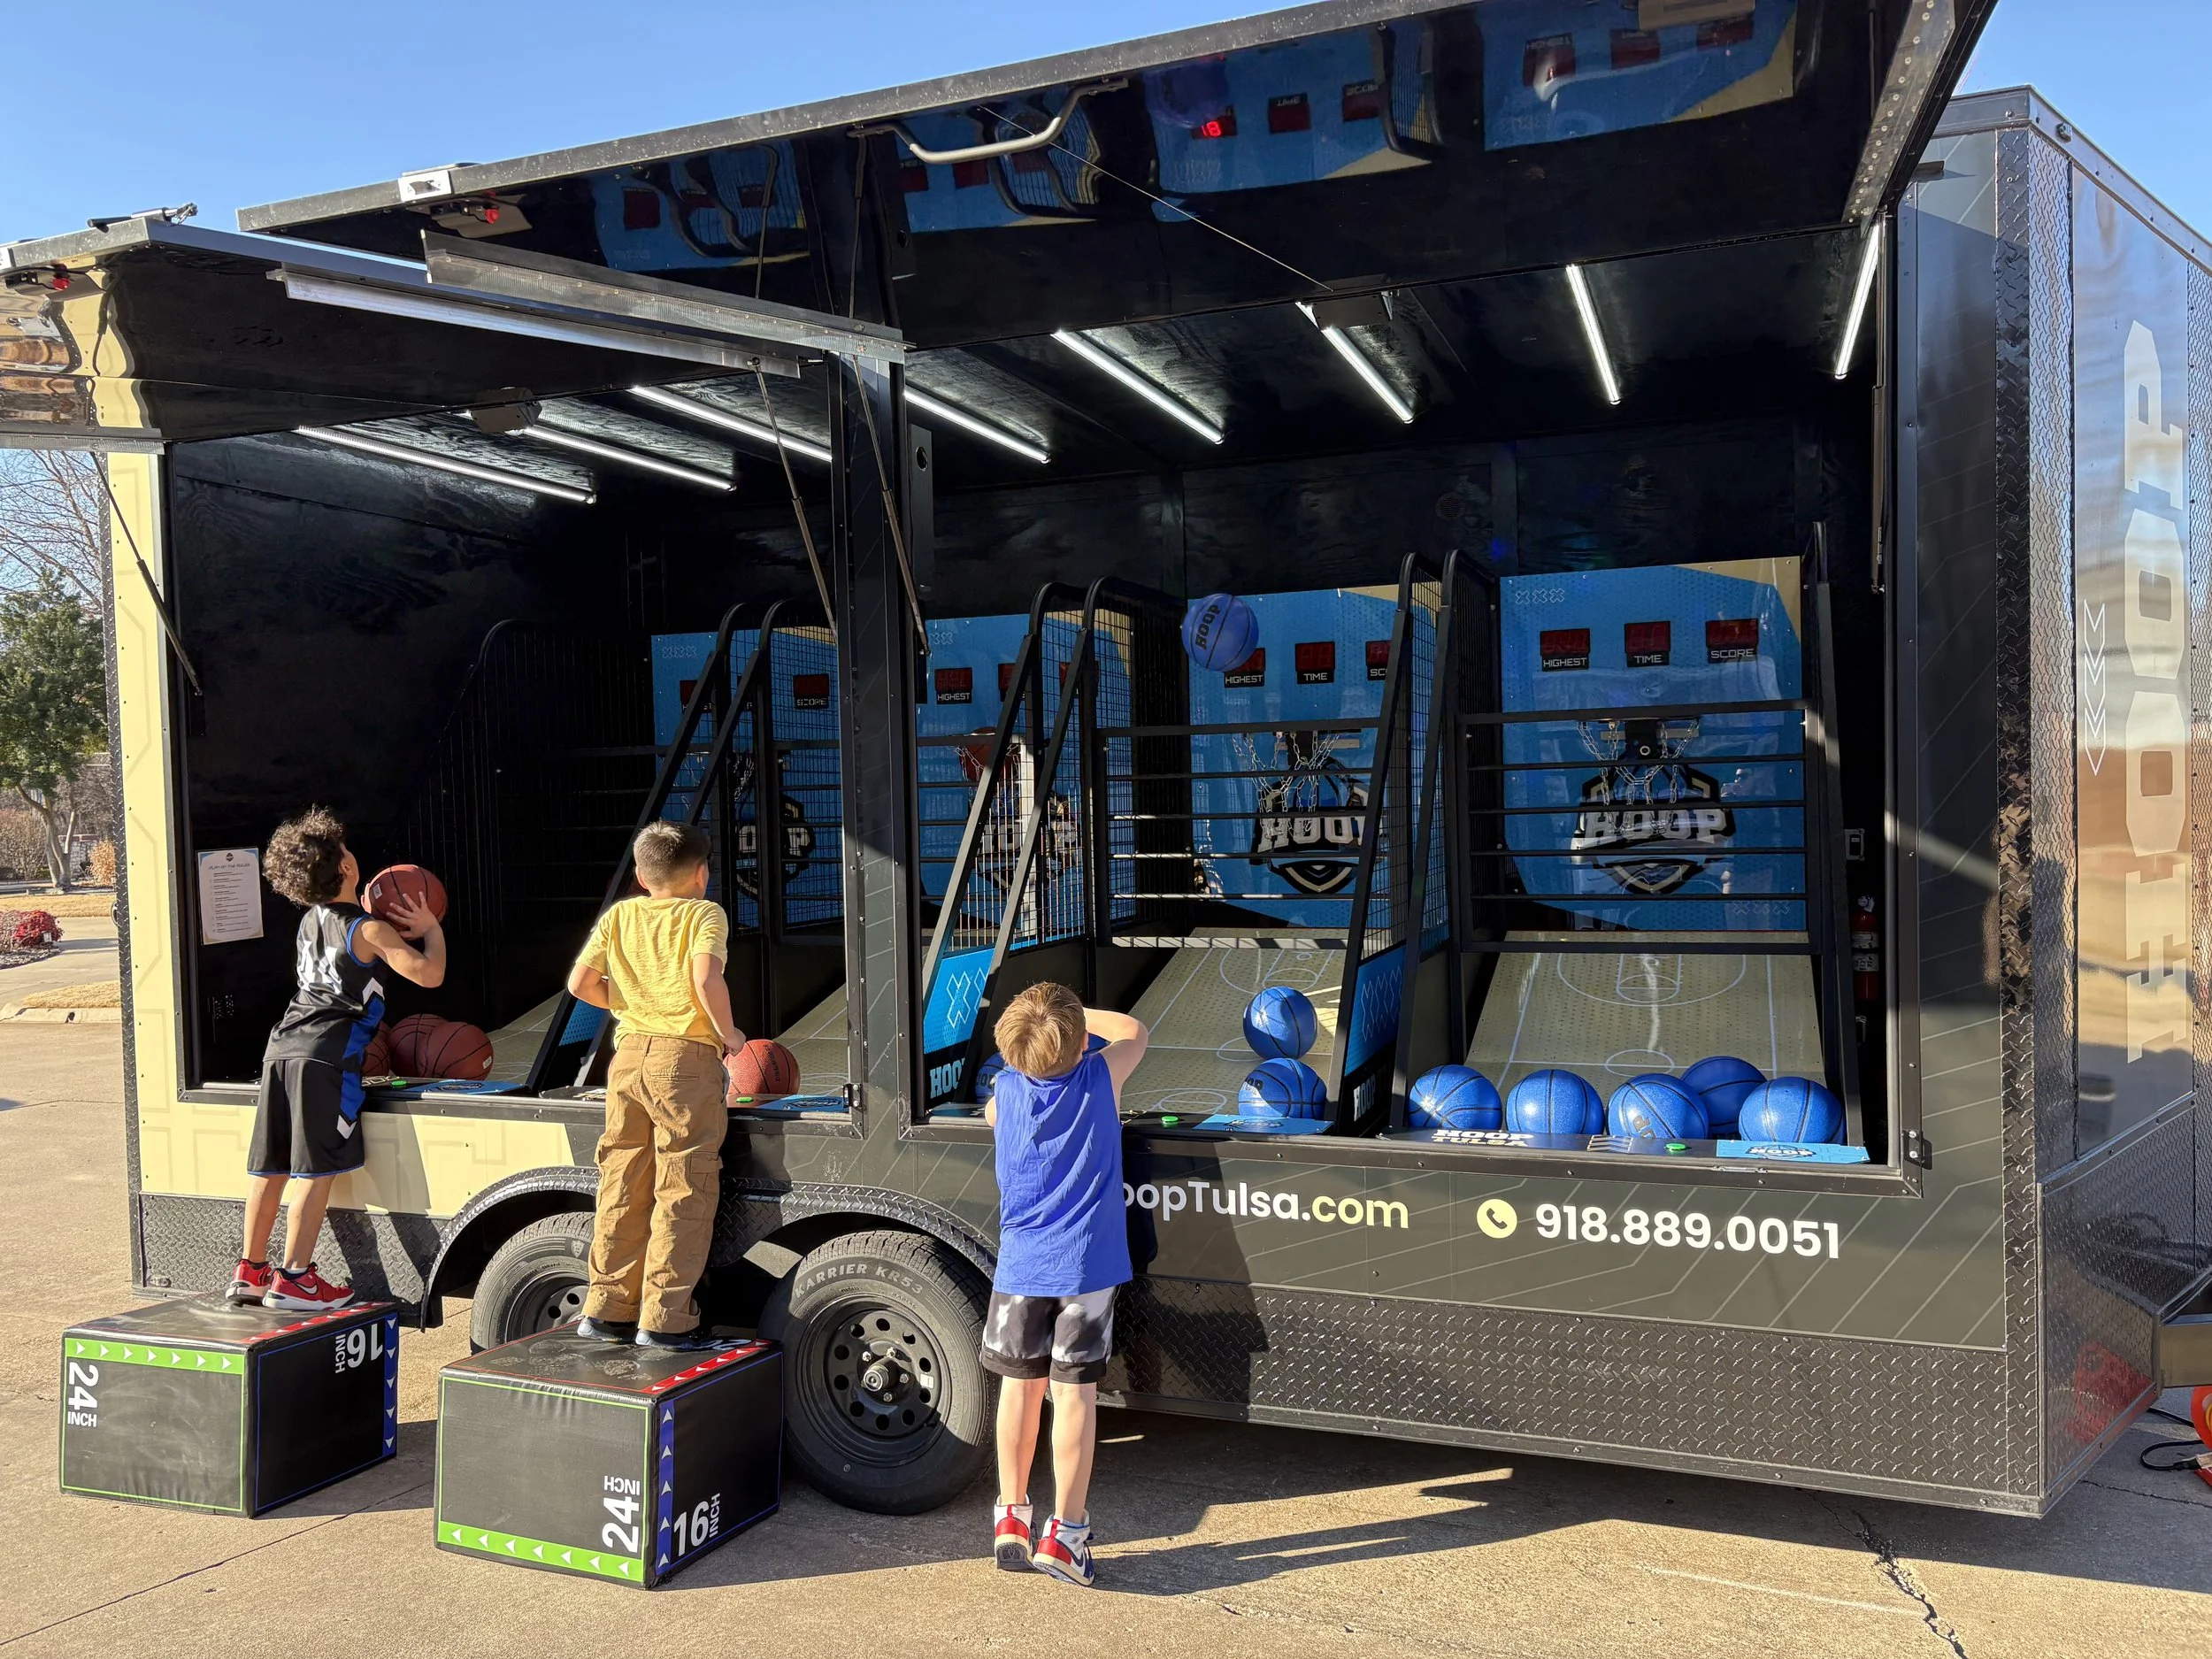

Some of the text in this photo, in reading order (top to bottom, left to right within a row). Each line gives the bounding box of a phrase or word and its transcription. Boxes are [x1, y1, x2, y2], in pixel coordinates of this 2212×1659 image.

[1195, 605, 1220, 651] HOOP
[1543, 657, 1587, 668] HIGHEST
[1634, 655, 1662, 664] TIME
[1710, 649, 1754, 659] SCORE
[1225, 674, 1263, 685] HIGHEST
[1303, 672, 1328, 681] TIME
[937, 692, 971, 702] HIGHEST
[929, 1057, 965, 1099] HOO
[1432, 1129, 1534, 1141] HOOP
[1432, 1136, 1529, 1148] TULSA
[1122, 1179, 1409, 1229] oopTulsa.com
[1535, 1202, 1840, 1260] 918.889.0051
[795, 1263, 924, 1299] KARRIER KR53
[334, 1323, 383, 1375] 16 INCH
[67, 1362, 99, 1428] 24 INCH
[602, 1475, 641, 1555] 24 INCH
[673, 1492, 721, 1557] 16 INCH
